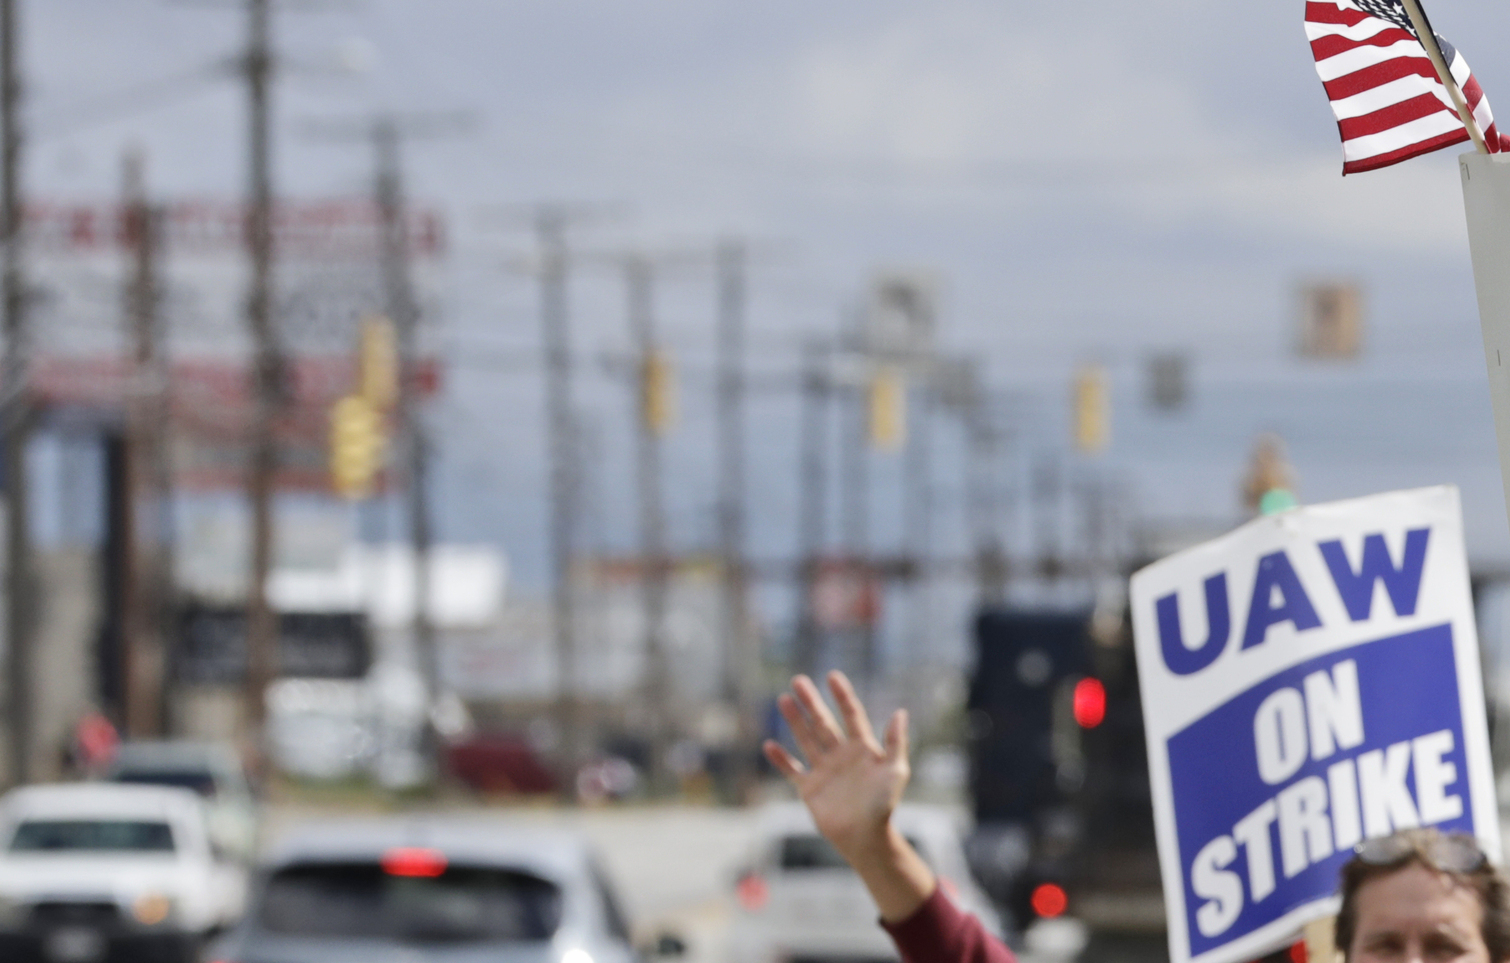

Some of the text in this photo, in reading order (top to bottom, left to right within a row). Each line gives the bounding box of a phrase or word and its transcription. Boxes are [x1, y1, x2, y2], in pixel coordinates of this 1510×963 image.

[1155, 527, 1432, 675] UAW
[1253, 658, 1365, 785] ON
[1190, 729, 1464, 938] STRIKE
